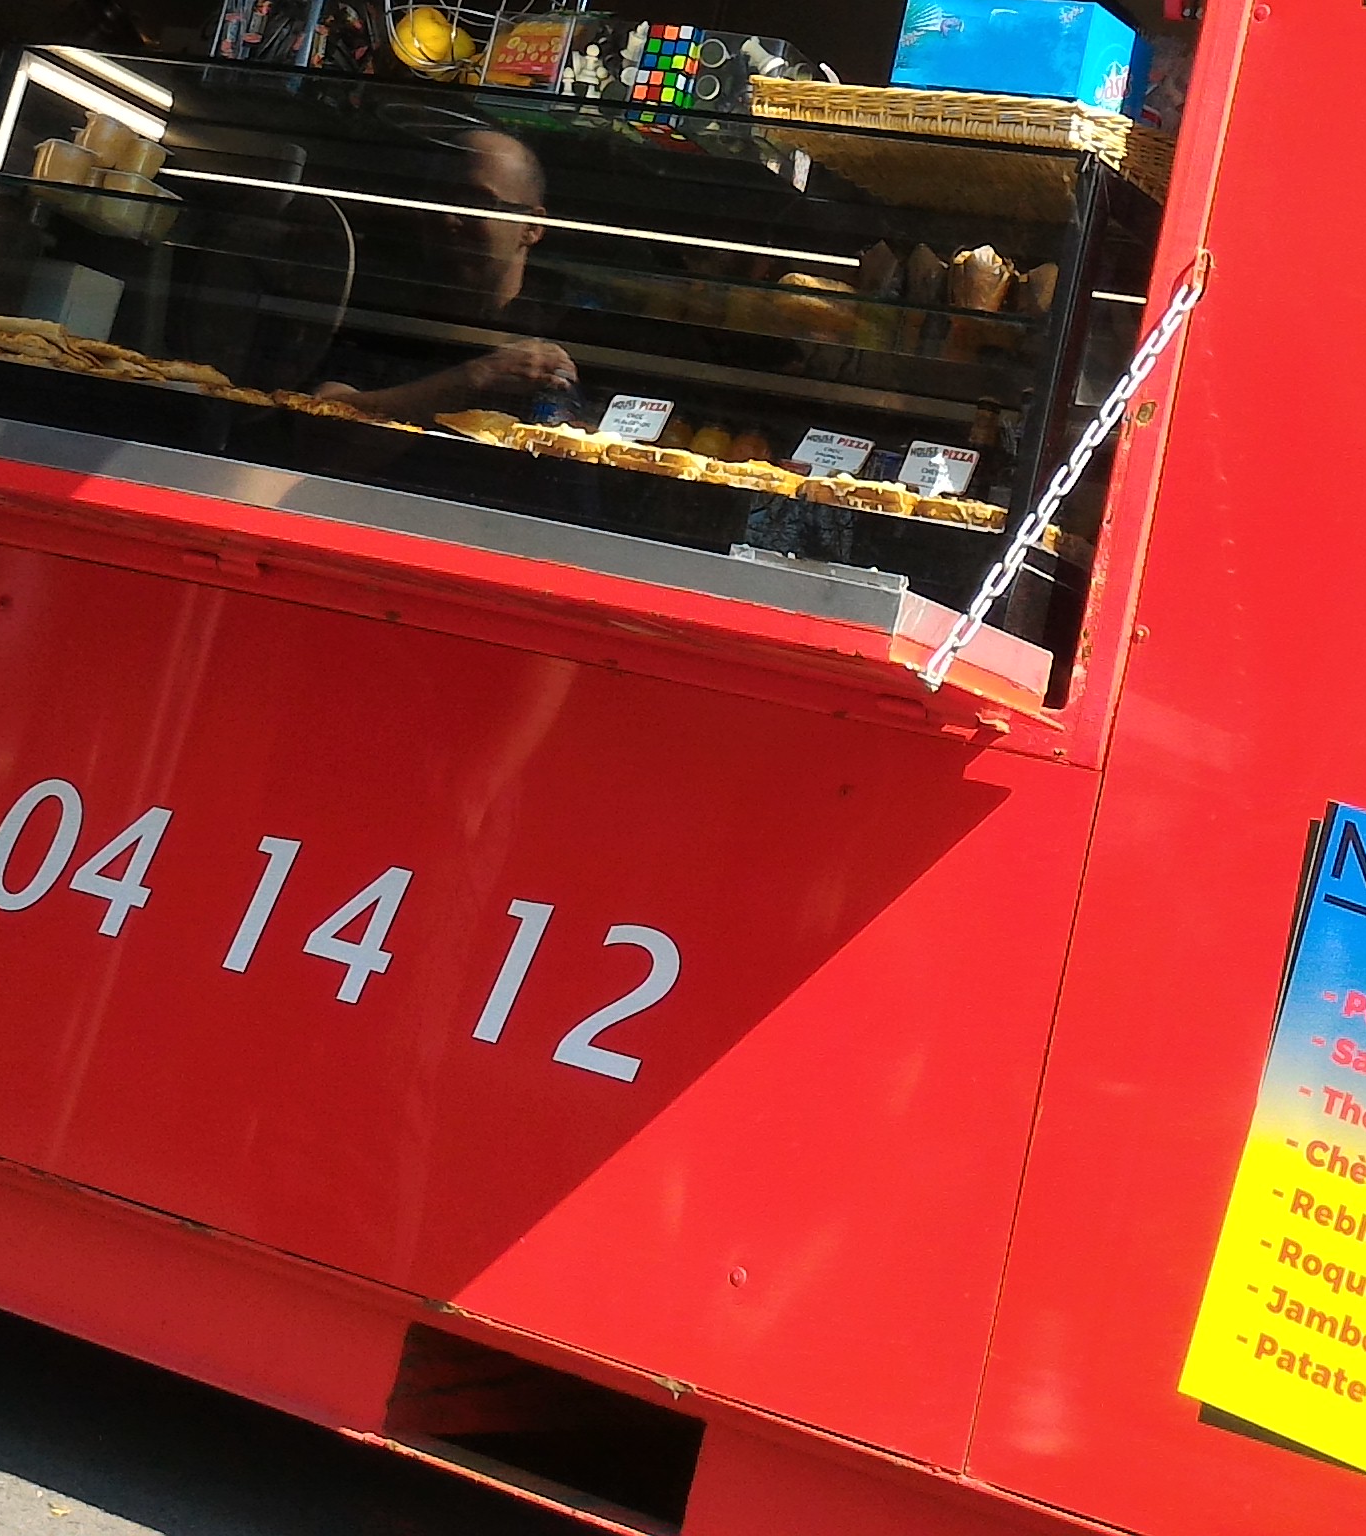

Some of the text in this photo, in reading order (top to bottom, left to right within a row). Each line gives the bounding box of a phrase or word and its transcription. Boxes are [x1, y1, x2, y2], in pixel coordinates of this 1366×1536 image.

[836, 436, 871, 452] PIZZA
[941, 448, 974, 464] PIZZA
[221, 834, 415, 1006] 14
[471, 896, 683, 1085] 12
